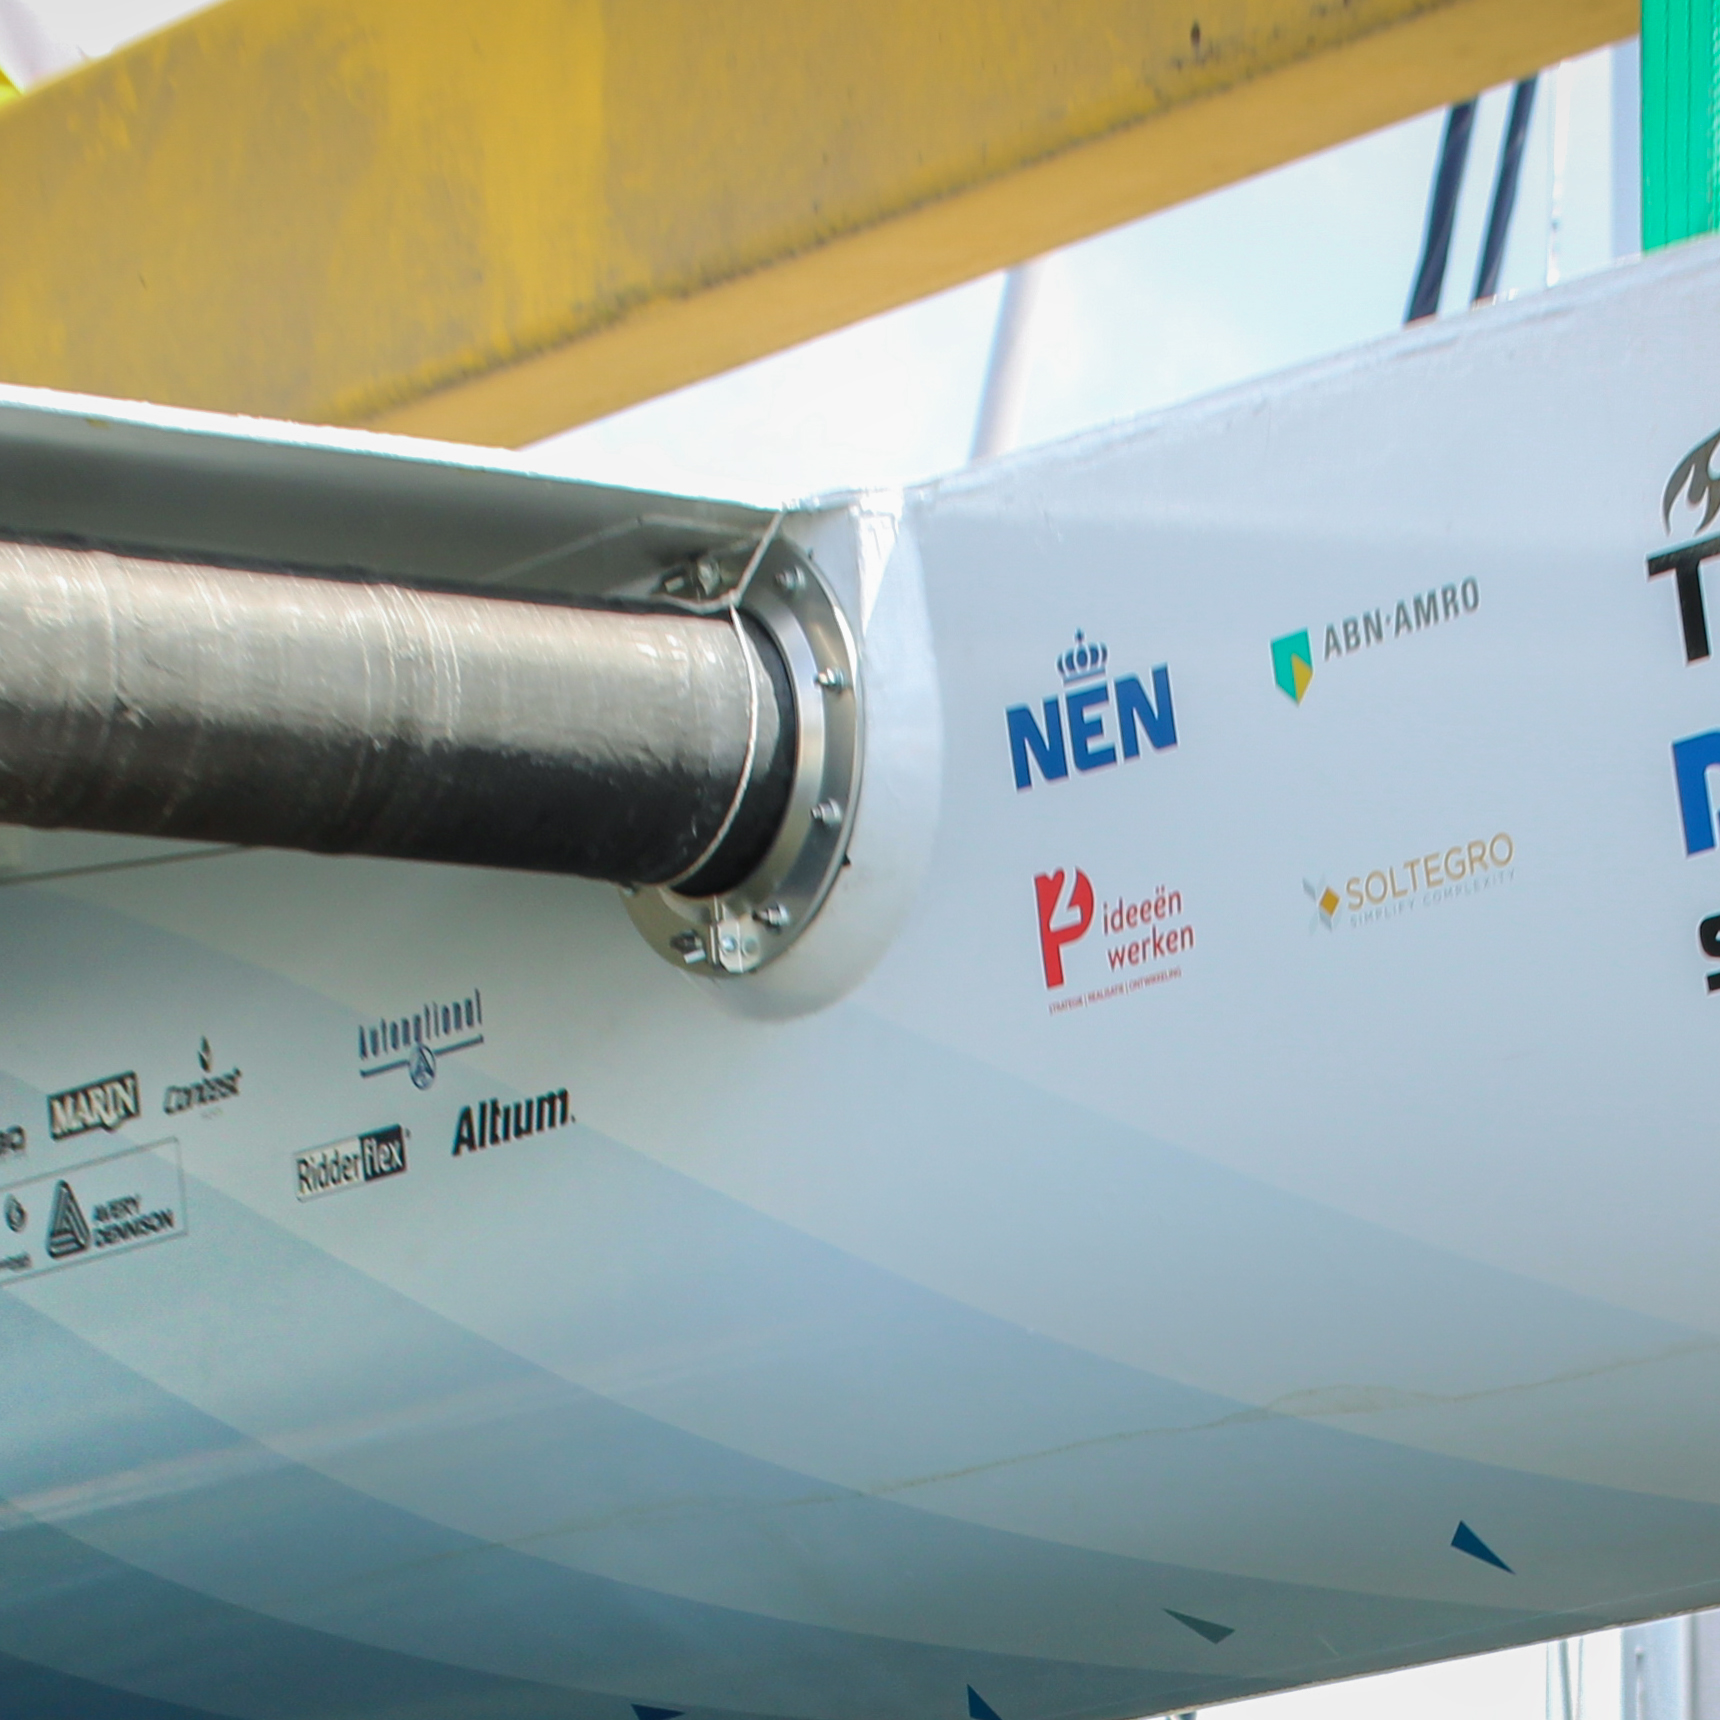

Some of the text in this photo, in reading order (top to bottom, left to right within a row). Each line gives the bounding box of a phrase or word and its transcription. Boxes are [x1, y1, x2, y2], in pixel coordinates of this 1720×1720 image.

[1005, 662, 1178, 792] NEN
[1345, 831, 1515, 912] SOLTEGRO
[1349, 868, 1516, 928] SIMPLIFY COMPLEXITY
[1102, 884, 1182, 936] ideeën
[1107, 923, 1194, 972] werken
[49, 1076, 139, 1137] MARIN
[451, 1087, 570, 1157] Altium
